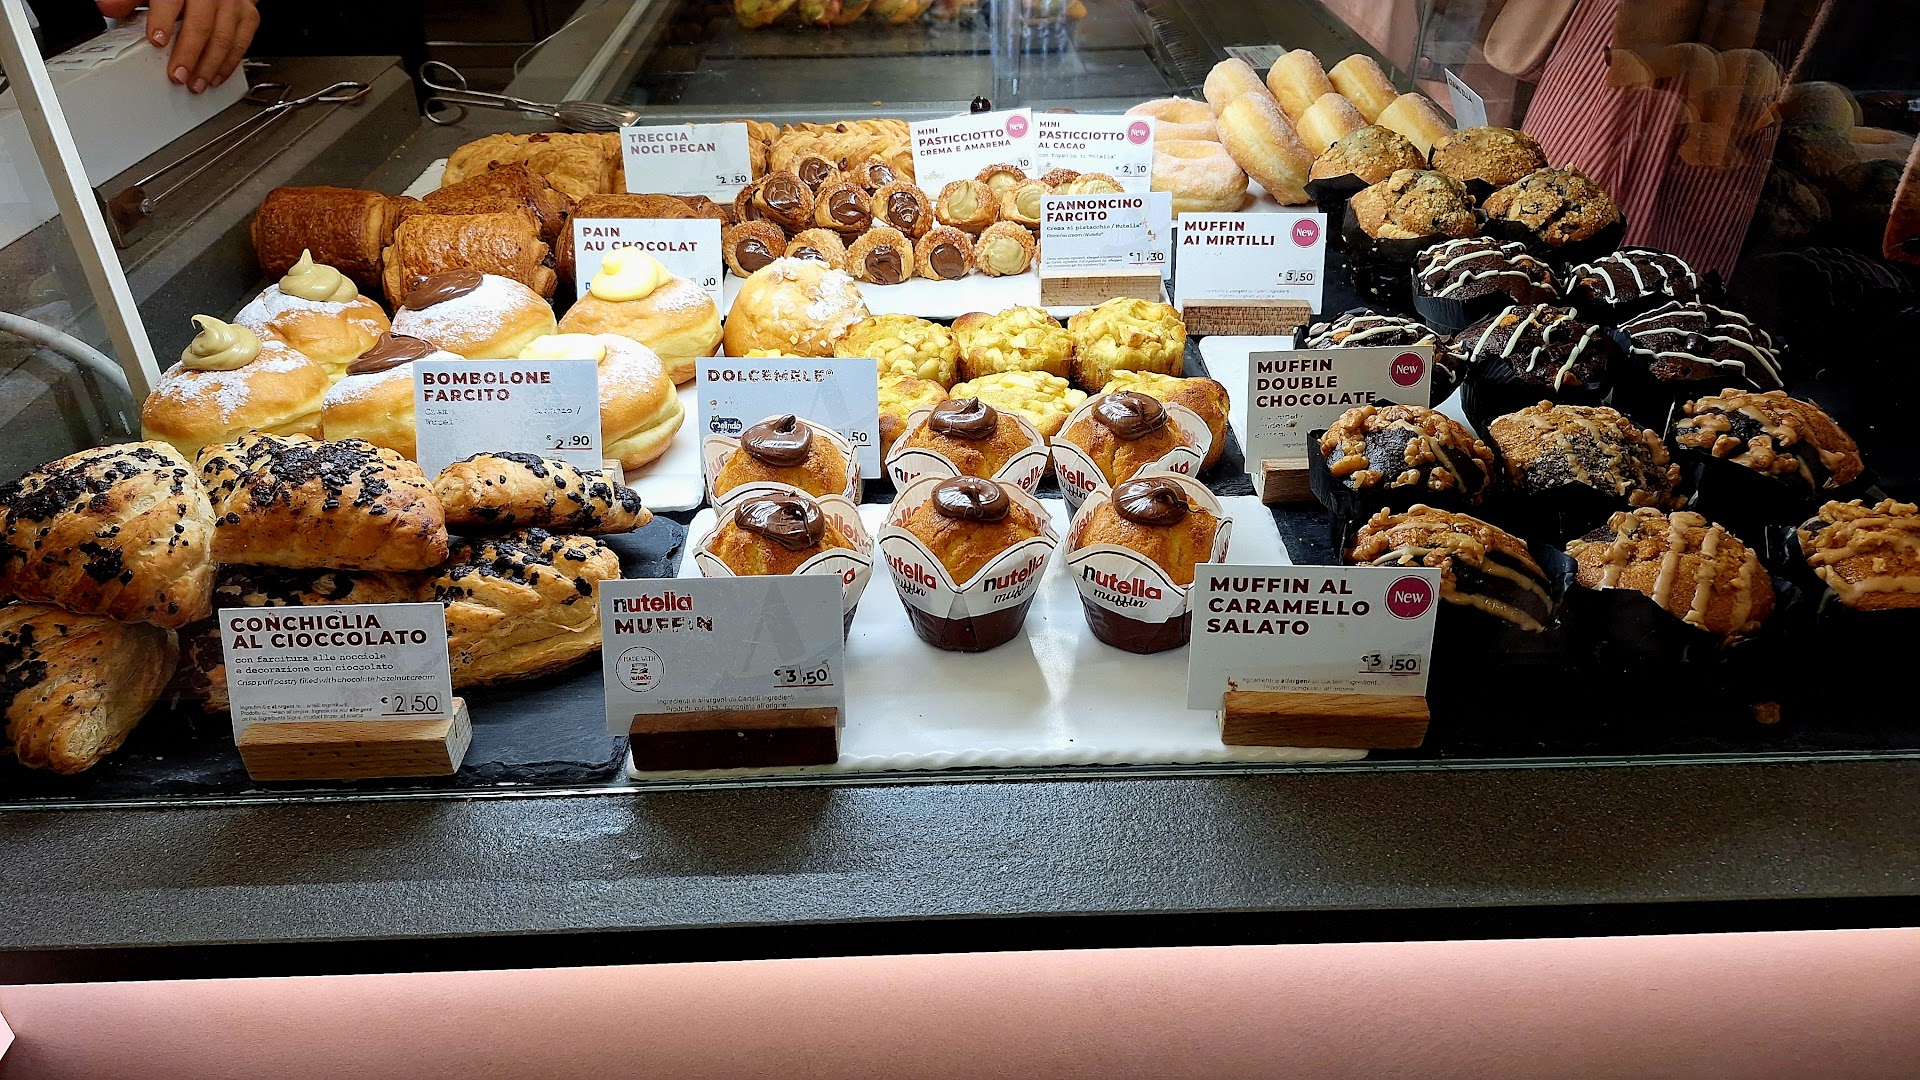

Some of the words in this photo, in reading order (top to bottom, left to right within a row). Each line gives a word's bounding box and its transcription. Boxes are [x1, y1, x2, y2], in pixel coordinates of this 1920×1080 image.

[628, 132, 689, 143] TRECCIA
[917, 127, 938, 136] MINI
[918, 129, 1004, 147] PASTICCIOTTO
[1008, 122, 1025, 131] New
[1039, 130, 1125, 141] PASTICCIOTTO
[1130, 128, 1146, 137] New
[630, 144, 665, 155] NOCI
[669, 142, 716, 153] PECAN
[920, 146, 953, 156] CREMA
[964, 139, 1011, 152] AMARENA
[1053, 142, 1086, 150] CACAO
[1046, 198, 1143, 211] CANNONCINO
[1046, 211, 1107, 222] FARCITO
[582, 227, 621, 237] PAIN
[1184, 221, 1245, 232] MUFFIN
[1296, 228, 1315, 237] New
[583, 241, 605, 252] AU
[1183, 235, 1200, 246] AI
[1206, 235, 1275, 246] MIRTILLI
[1257, 358, 1333, 374] MUFFIN
[1395, 363, 1419, 375] New
[422, 371, 552, 385] BOMBOLONE
[1257, 375, 1338, 391] DOUBLE
[423, 388, 511, 402] FARCITO
[1256, 391, 1376, 407] CHOCOLATE
[983, 553, 1045, 593] nutella
[993, 576, 1034, 604] muffin
[1083, 564, 1162, 601] nutella
[1209, 576, 1310, 594] MUFFIN
[1318, 579, 1353, 595] AL
[1394, 590, 1424, 604] New
[612, 591, 694, 613] nutella
[1093, 587, 1148, 608] muffin
[1208, 597, 1370, 616] CARAMELLO
[230, 614, 382, 632] CONCHIGLIA
[614, 616, 714, 635] MUFFIN
[1206, 618, 1310, 636] SALATO
[232, 634, 263, 650] AL
[270, 630, 427, 648] CIOCCOLATO
[235, 656, 254, 664] con
[257, 655, 309, 663] farcitura
[312, 653, 336, 661] alle
[339, 652, 387, 661] nocciole
[245, 665, 310, 674] decorazione
[335, 663, 394, 671] cioccolato
[237, 679, 256, 687] Crisp
[257, 678, 273, 687] puff
[273, 678, 297, 686] pastry
[319, 676, 337, 684] with
[338, 675, 375, 683] chocolate
[375, 674, 410, 682] hazelnut
[380, 696, 389, 704] €
[394, 695, 438, 713] 2,50
